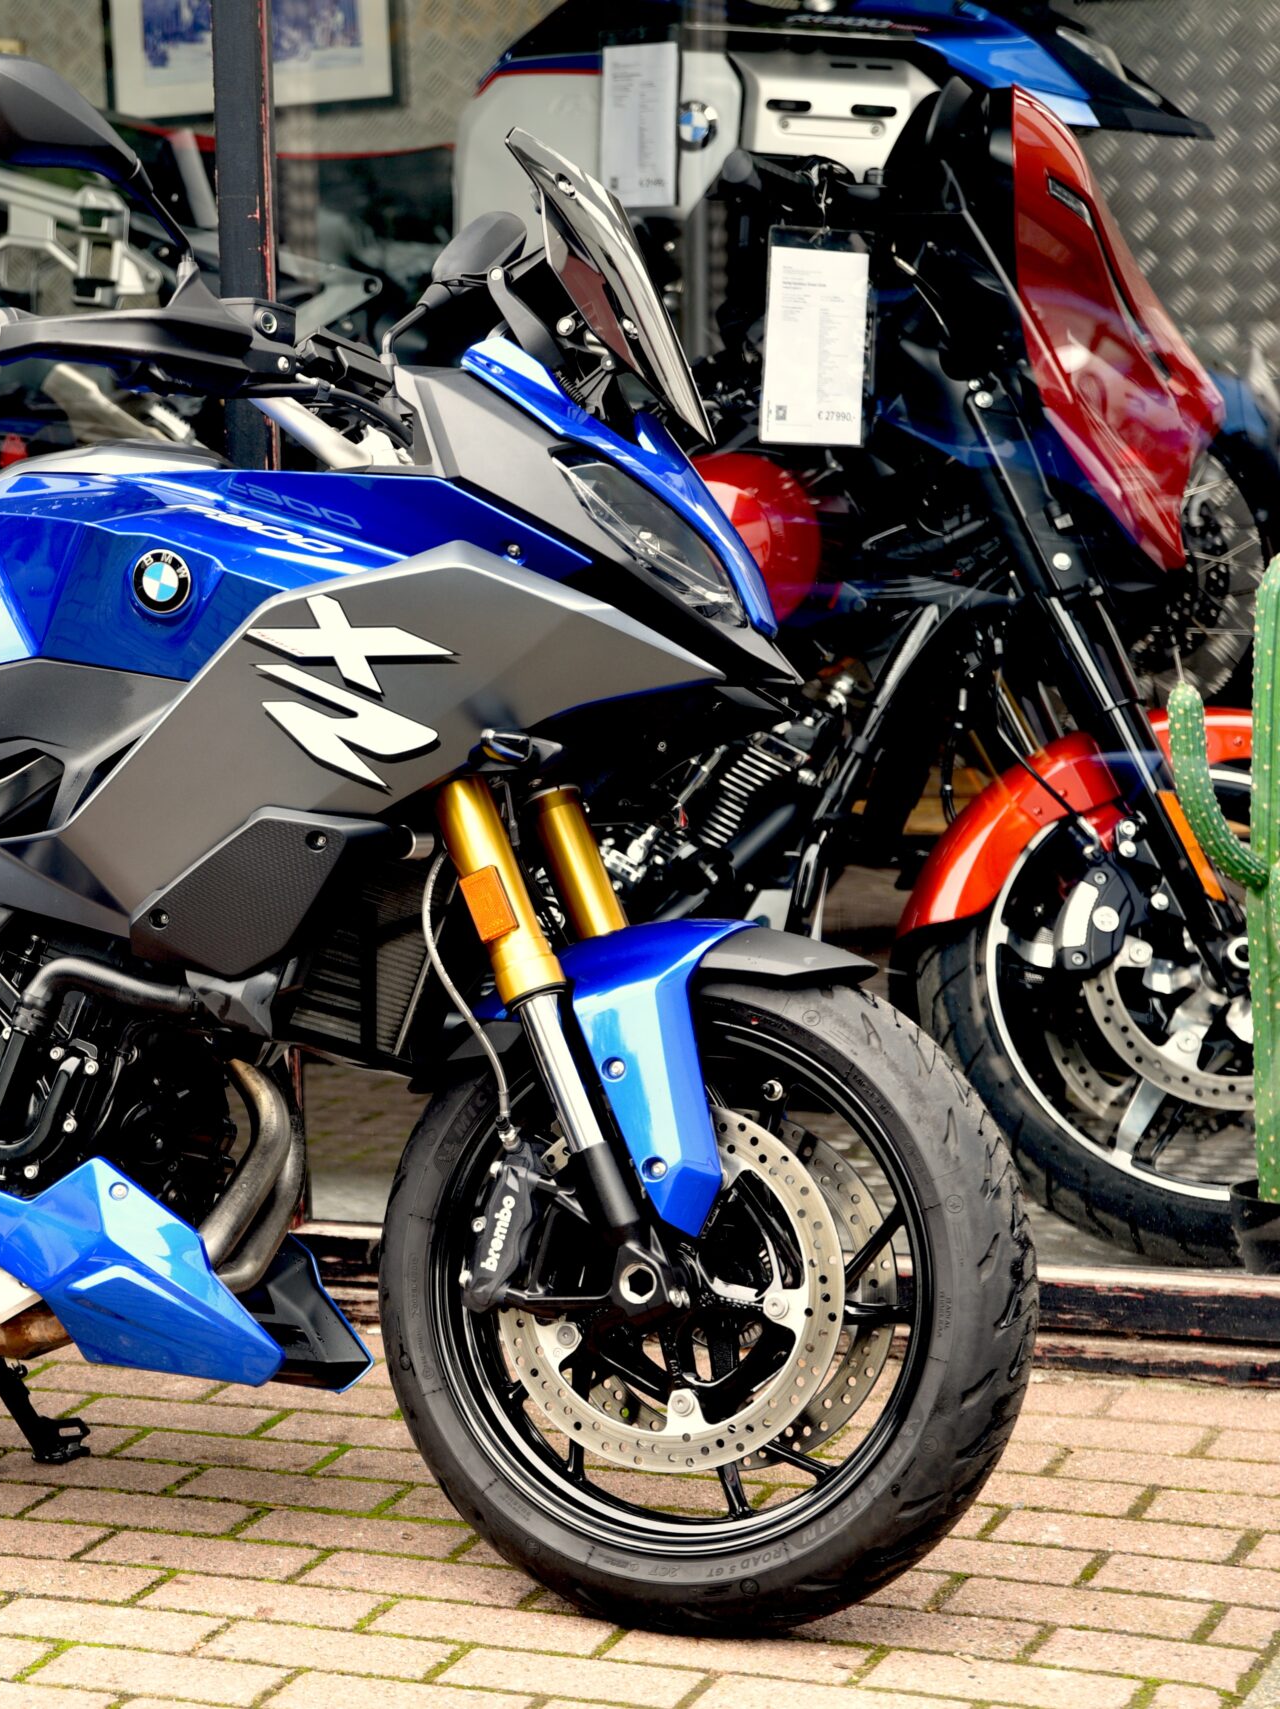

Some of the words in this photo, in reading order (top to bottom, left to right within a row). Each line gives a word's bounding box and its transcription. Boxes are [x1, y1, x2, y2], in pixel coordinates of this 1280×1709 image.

[143, 552, 189, 579] BMW
[480, 1195, 516, 1272] brembo
[801, 1440, 903, 1545] MICHELIN
[728, 1564, 737, 1575] 5
[740, 1549, 783, 1570] ROAD
[706, 1567, 724, 1578] GT
